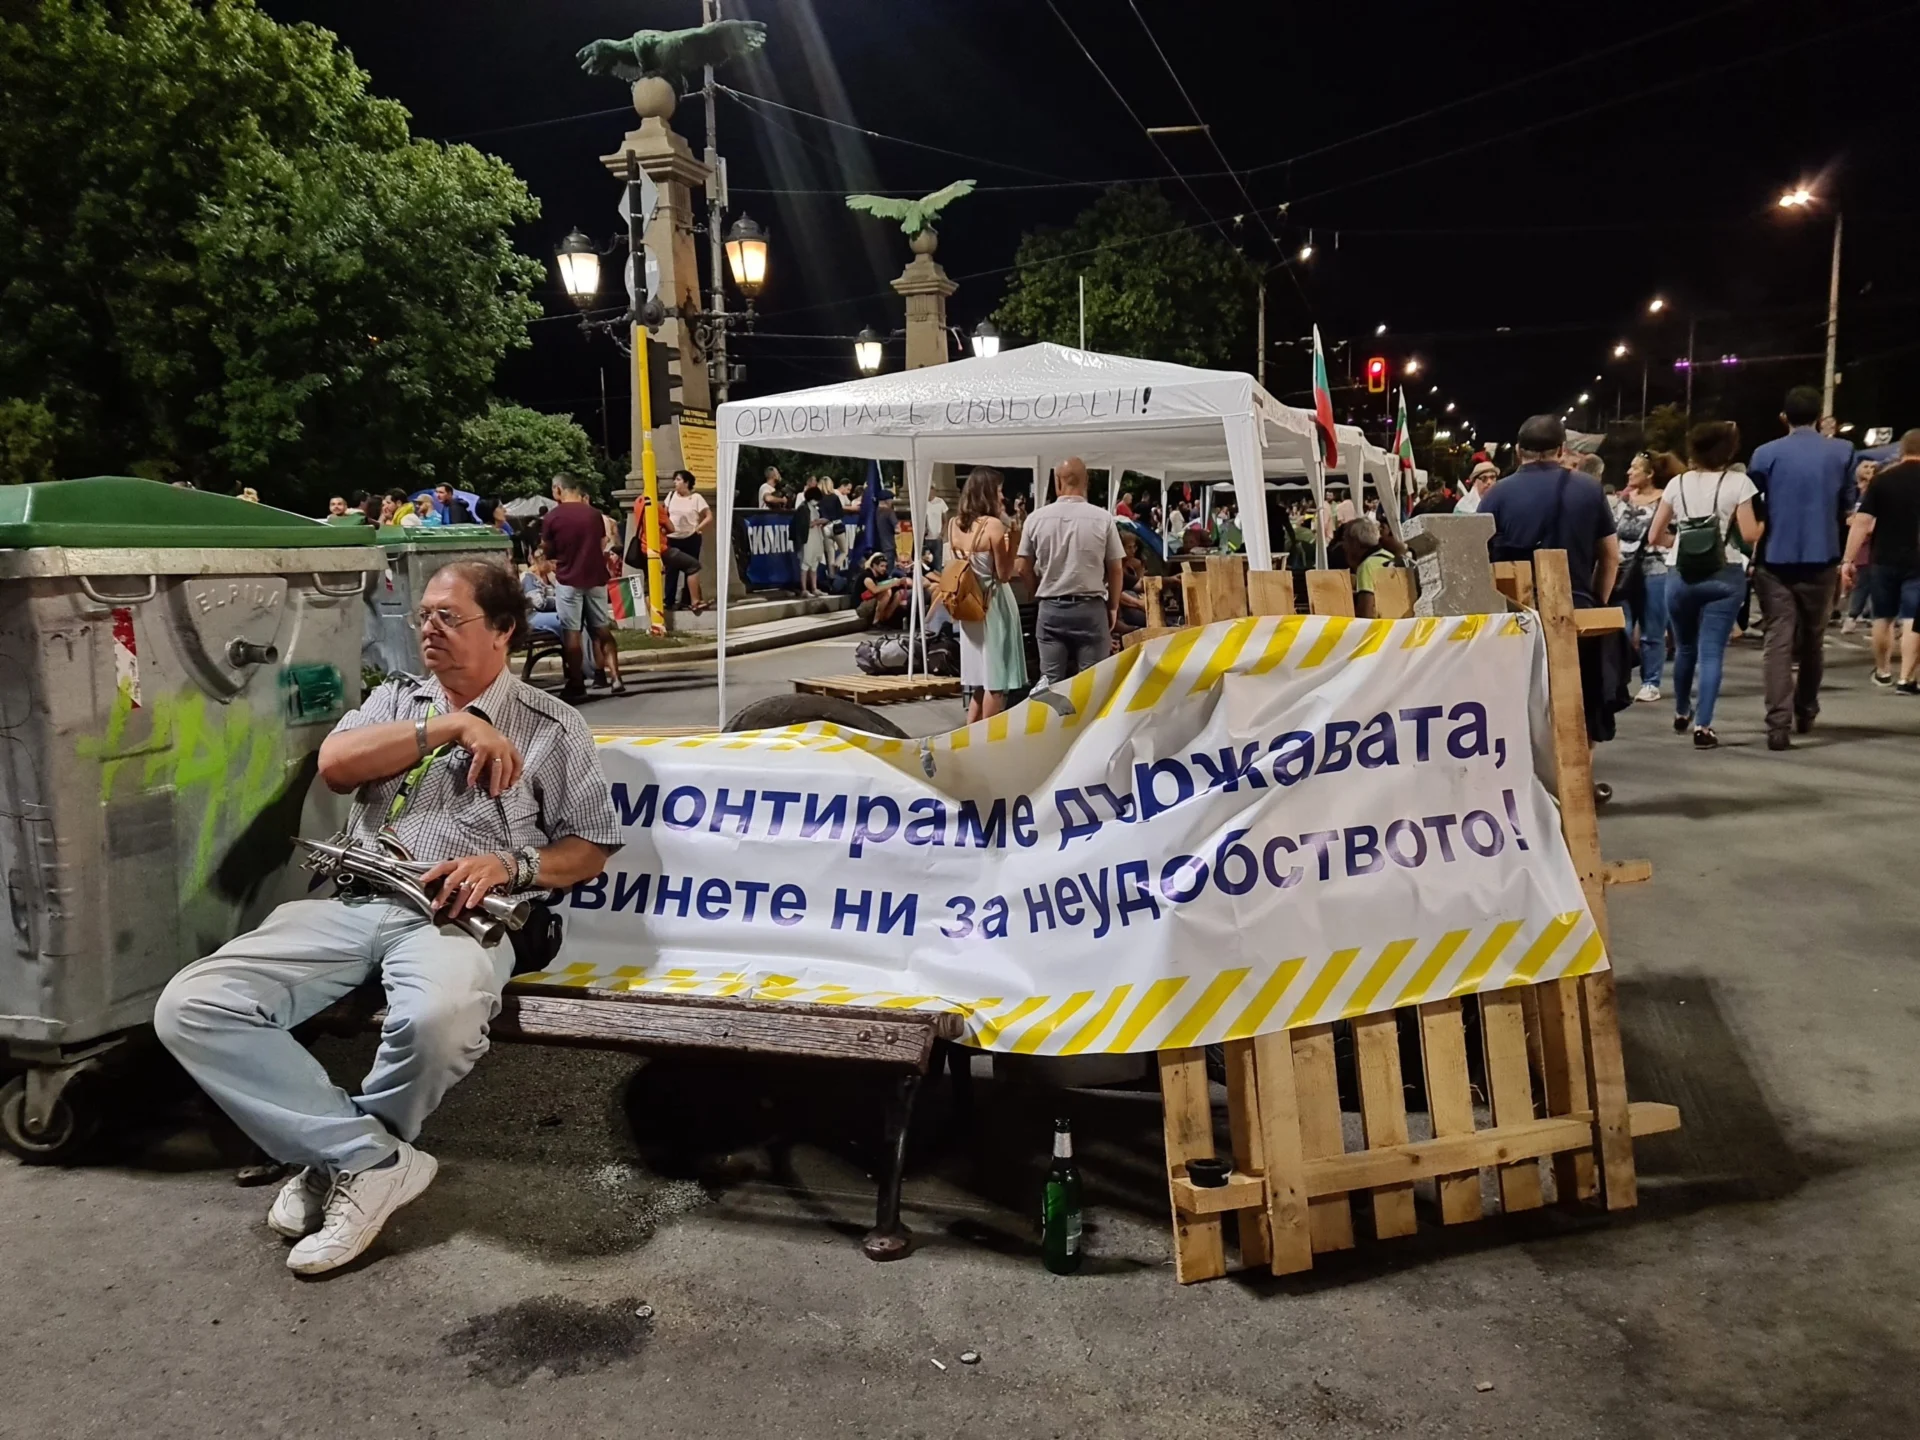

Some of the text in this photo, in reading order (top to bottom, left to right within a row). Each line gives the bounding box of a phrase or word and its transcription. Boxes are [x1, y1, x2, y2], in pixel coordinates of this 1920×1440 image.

[735, 406, 825, 437] ОРЛОВ
[946, 387, 1152, 425] СВОБОДЕН!
[1054, 701, 1506, 852] държавата,
[830, 887, 919, 937] ни
[940, 894, 1009, 940] за
[1023, 788, 1530, 940] неудобството!
